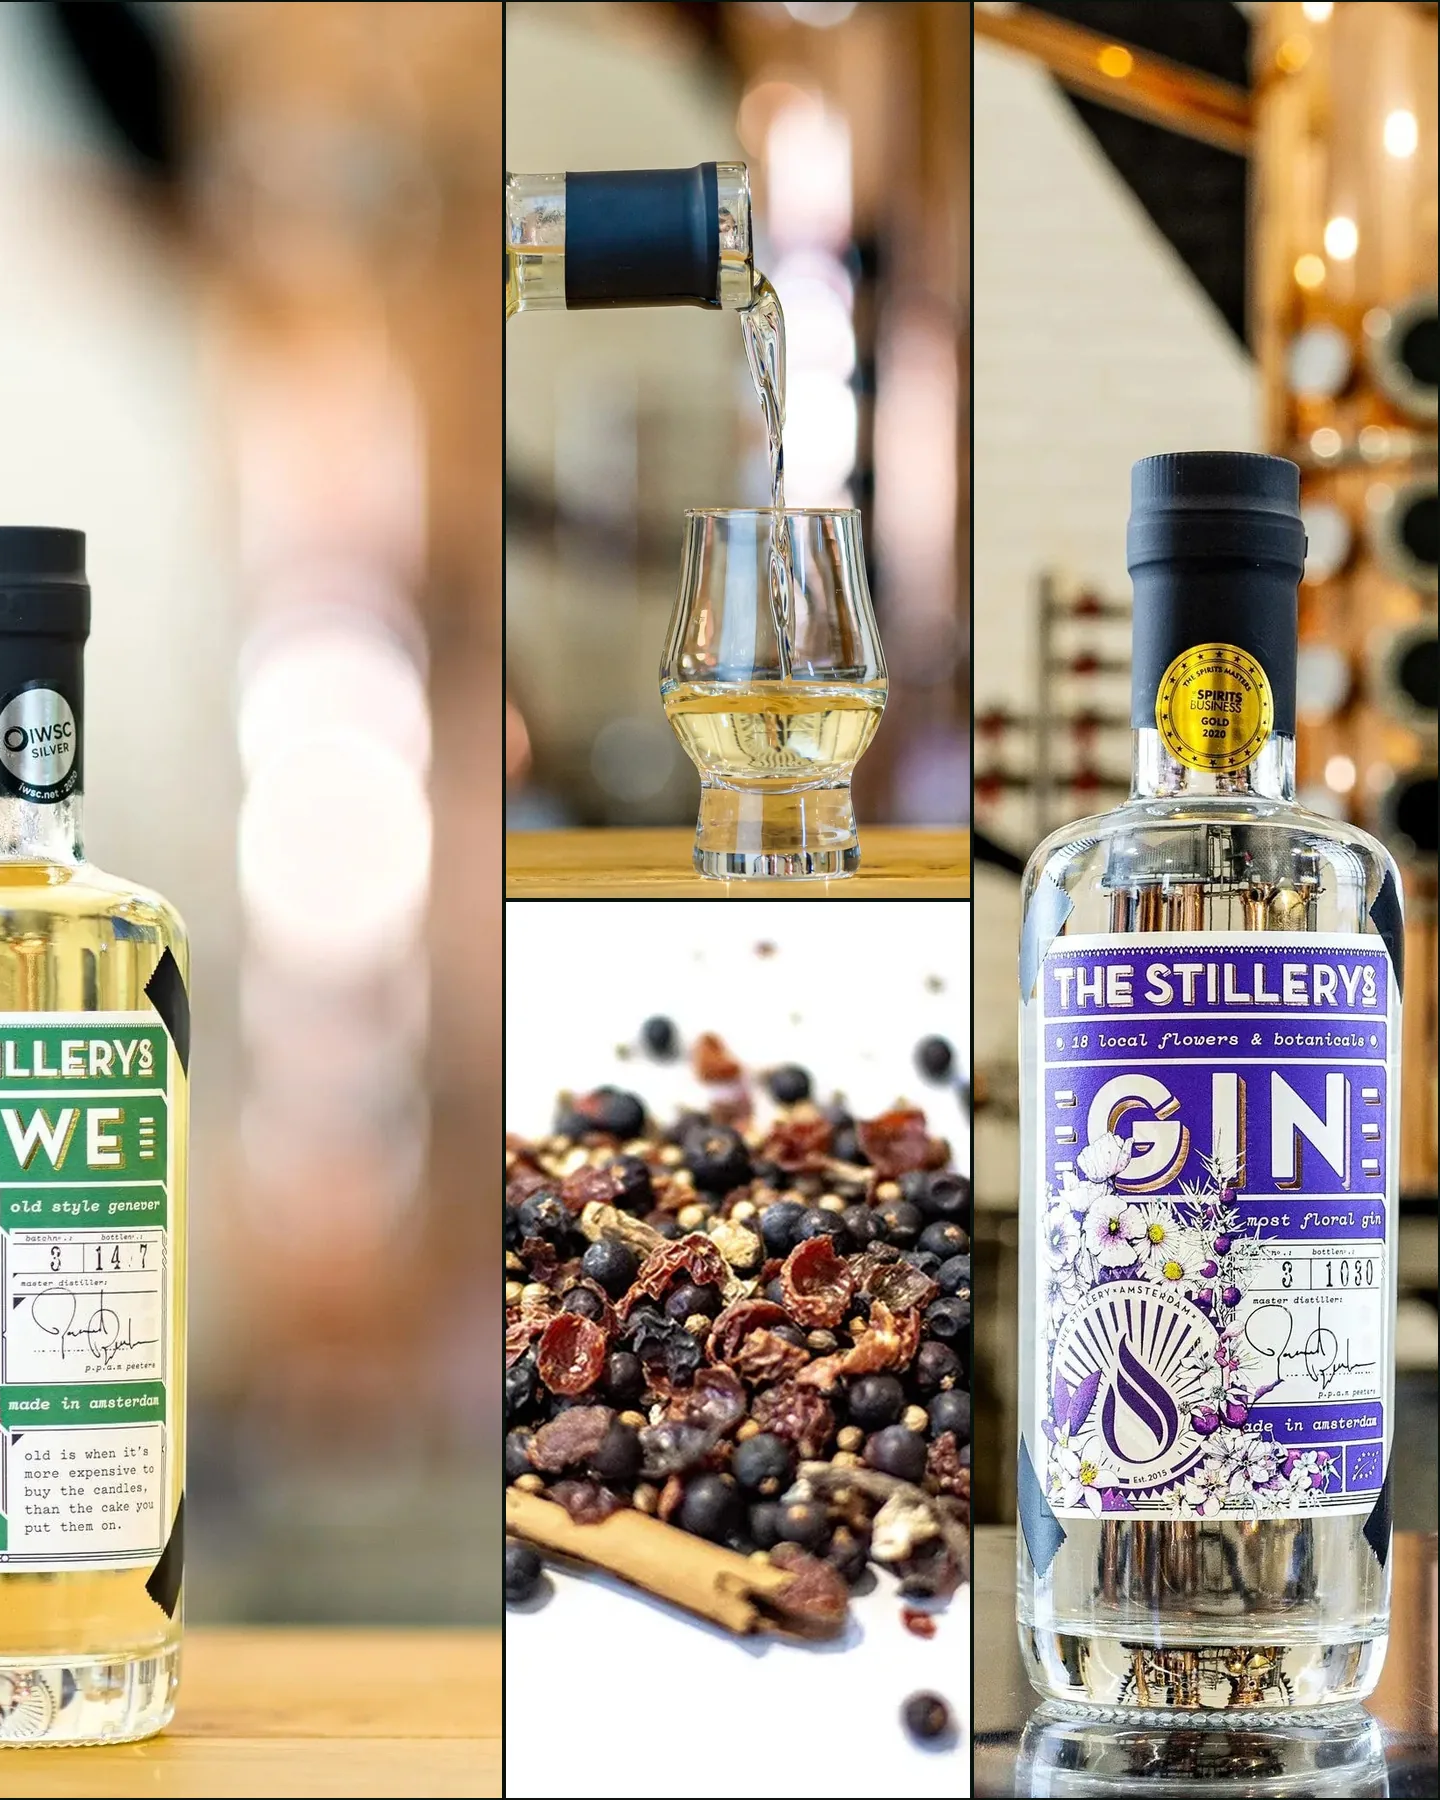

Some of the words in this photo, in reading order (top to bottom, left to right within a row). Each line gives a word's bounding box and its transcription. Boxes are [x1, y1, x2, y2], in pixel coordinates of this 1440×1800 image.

[1183, 675, 1195, 687] THE
[1196, 666, 1222, 677] SPIRITS
[1224, 668, 1251, 692] MASTERS
[1197, 690, 1242, 702] SPIRITS
[1190, 700, 1241, 713] BUSINESS
[1201, 717, 1229, 726] GOLD
[1203, 729, 1226, 738] 2020
[32, 743, 69, 758] SILVER
[1053, 964, 1134, 1008] THE
[1071, 1035, 1088, 1049] 18
[1098, 1034, 1148, 1048] local
[1158, 1033, 1239, 1049] flowers
[1251, 1034, 1262, 1046] &
[1274, 1033, 1364, 1048] botanicals
[1087, 1071, 1351, 1192] GIN
[11, 1200, 41, 1213] old
[52, 1200, 100, 1215] style
[108, 1200, 161, 1214] genever
[1247, 1214, 1290, 1226] most
[1300, 1213, 1354, 1230] floral
[1362, 1212, 1381, 1228] gin
[51, 1246, 61, 1271] 3
[1282, 1261, 1293, 1288] 3
[1326, 1260, 1373, 1287] 1030
[1120, 1286, 1191, 1315] AMSTERDAM
[1293, 1296, 1342, 1304] distiller:
[8, 1398, 50, 1411] made
[61, 1398, 79, 1410] in
[89, 1396, 159, 1409] amsterdam
[1243, 1420, 1273, 1432] ade
[1286, 1418, 1304, 1431] in
[1313, 1415, 1377, 1430] amsterdam
[24, 1449, 51, 1461] old
[61, 1449, 76, 1461] is
[85, 1448, 116, 1459] when
[122, 1445, 149, 1458] it's
[24, 1468, 59, 1480] more
[69, 1466, 136, 1480] expensive
[143, 1464, 154, 1475] to
[1148, 1470, 1167, 1481] 2015
[24, 1486, 51, 1499] buy
[61, 1484, 84, 1496] the
[94, 1482, 148, 1496] candles,
[25, 1503, 60, 1516] than
[69, 1502, 92, 1514] the
[101, 1501, 130, 1513] cake
[136, 1500, 154, 1512] you
[24, 1521, 51, 1535] put
[61, 1520, 93, 1532] them
[101, 1520, 122, 1531] on.
